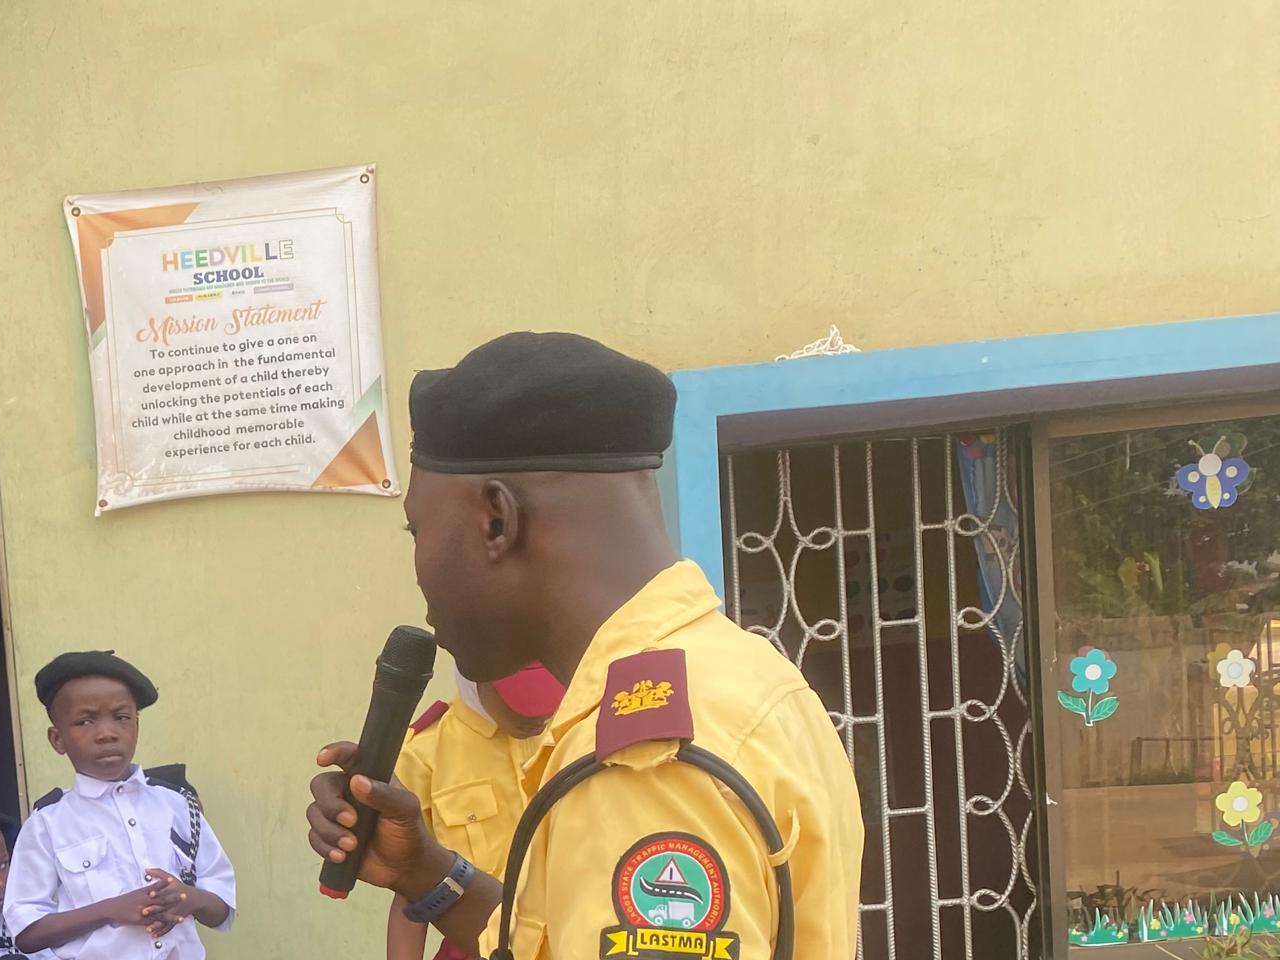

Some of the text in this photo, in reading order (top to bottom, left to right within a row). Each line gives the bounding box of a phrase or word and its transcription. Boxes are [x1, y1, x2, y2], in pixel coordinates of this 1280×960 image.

[162, 240, 294, 272] HEEDVILLE
[193, 266, 264, 285] SCHOOL
[136, 300, 328, 345] Mission Statement
[150, 334, 317, 359] To continue to give a one on
[134, 348, 336, 378] one approach in the fundamental
[143, 365, 329, 393] development of a child thereby
[141, 381, 333, 411] unlocking the potentials of each
[132, 397, 345, 428] child while at the same time making
[173, 419, 304, 441] childhood memorable
[165, 434, 316, 459] experience for each child.
[622, 842, 721, 928] LAGOS STATE TRAFFIC MANAGEMENT AUTHORITY
[640, 933, 703, 949] LASTMA
